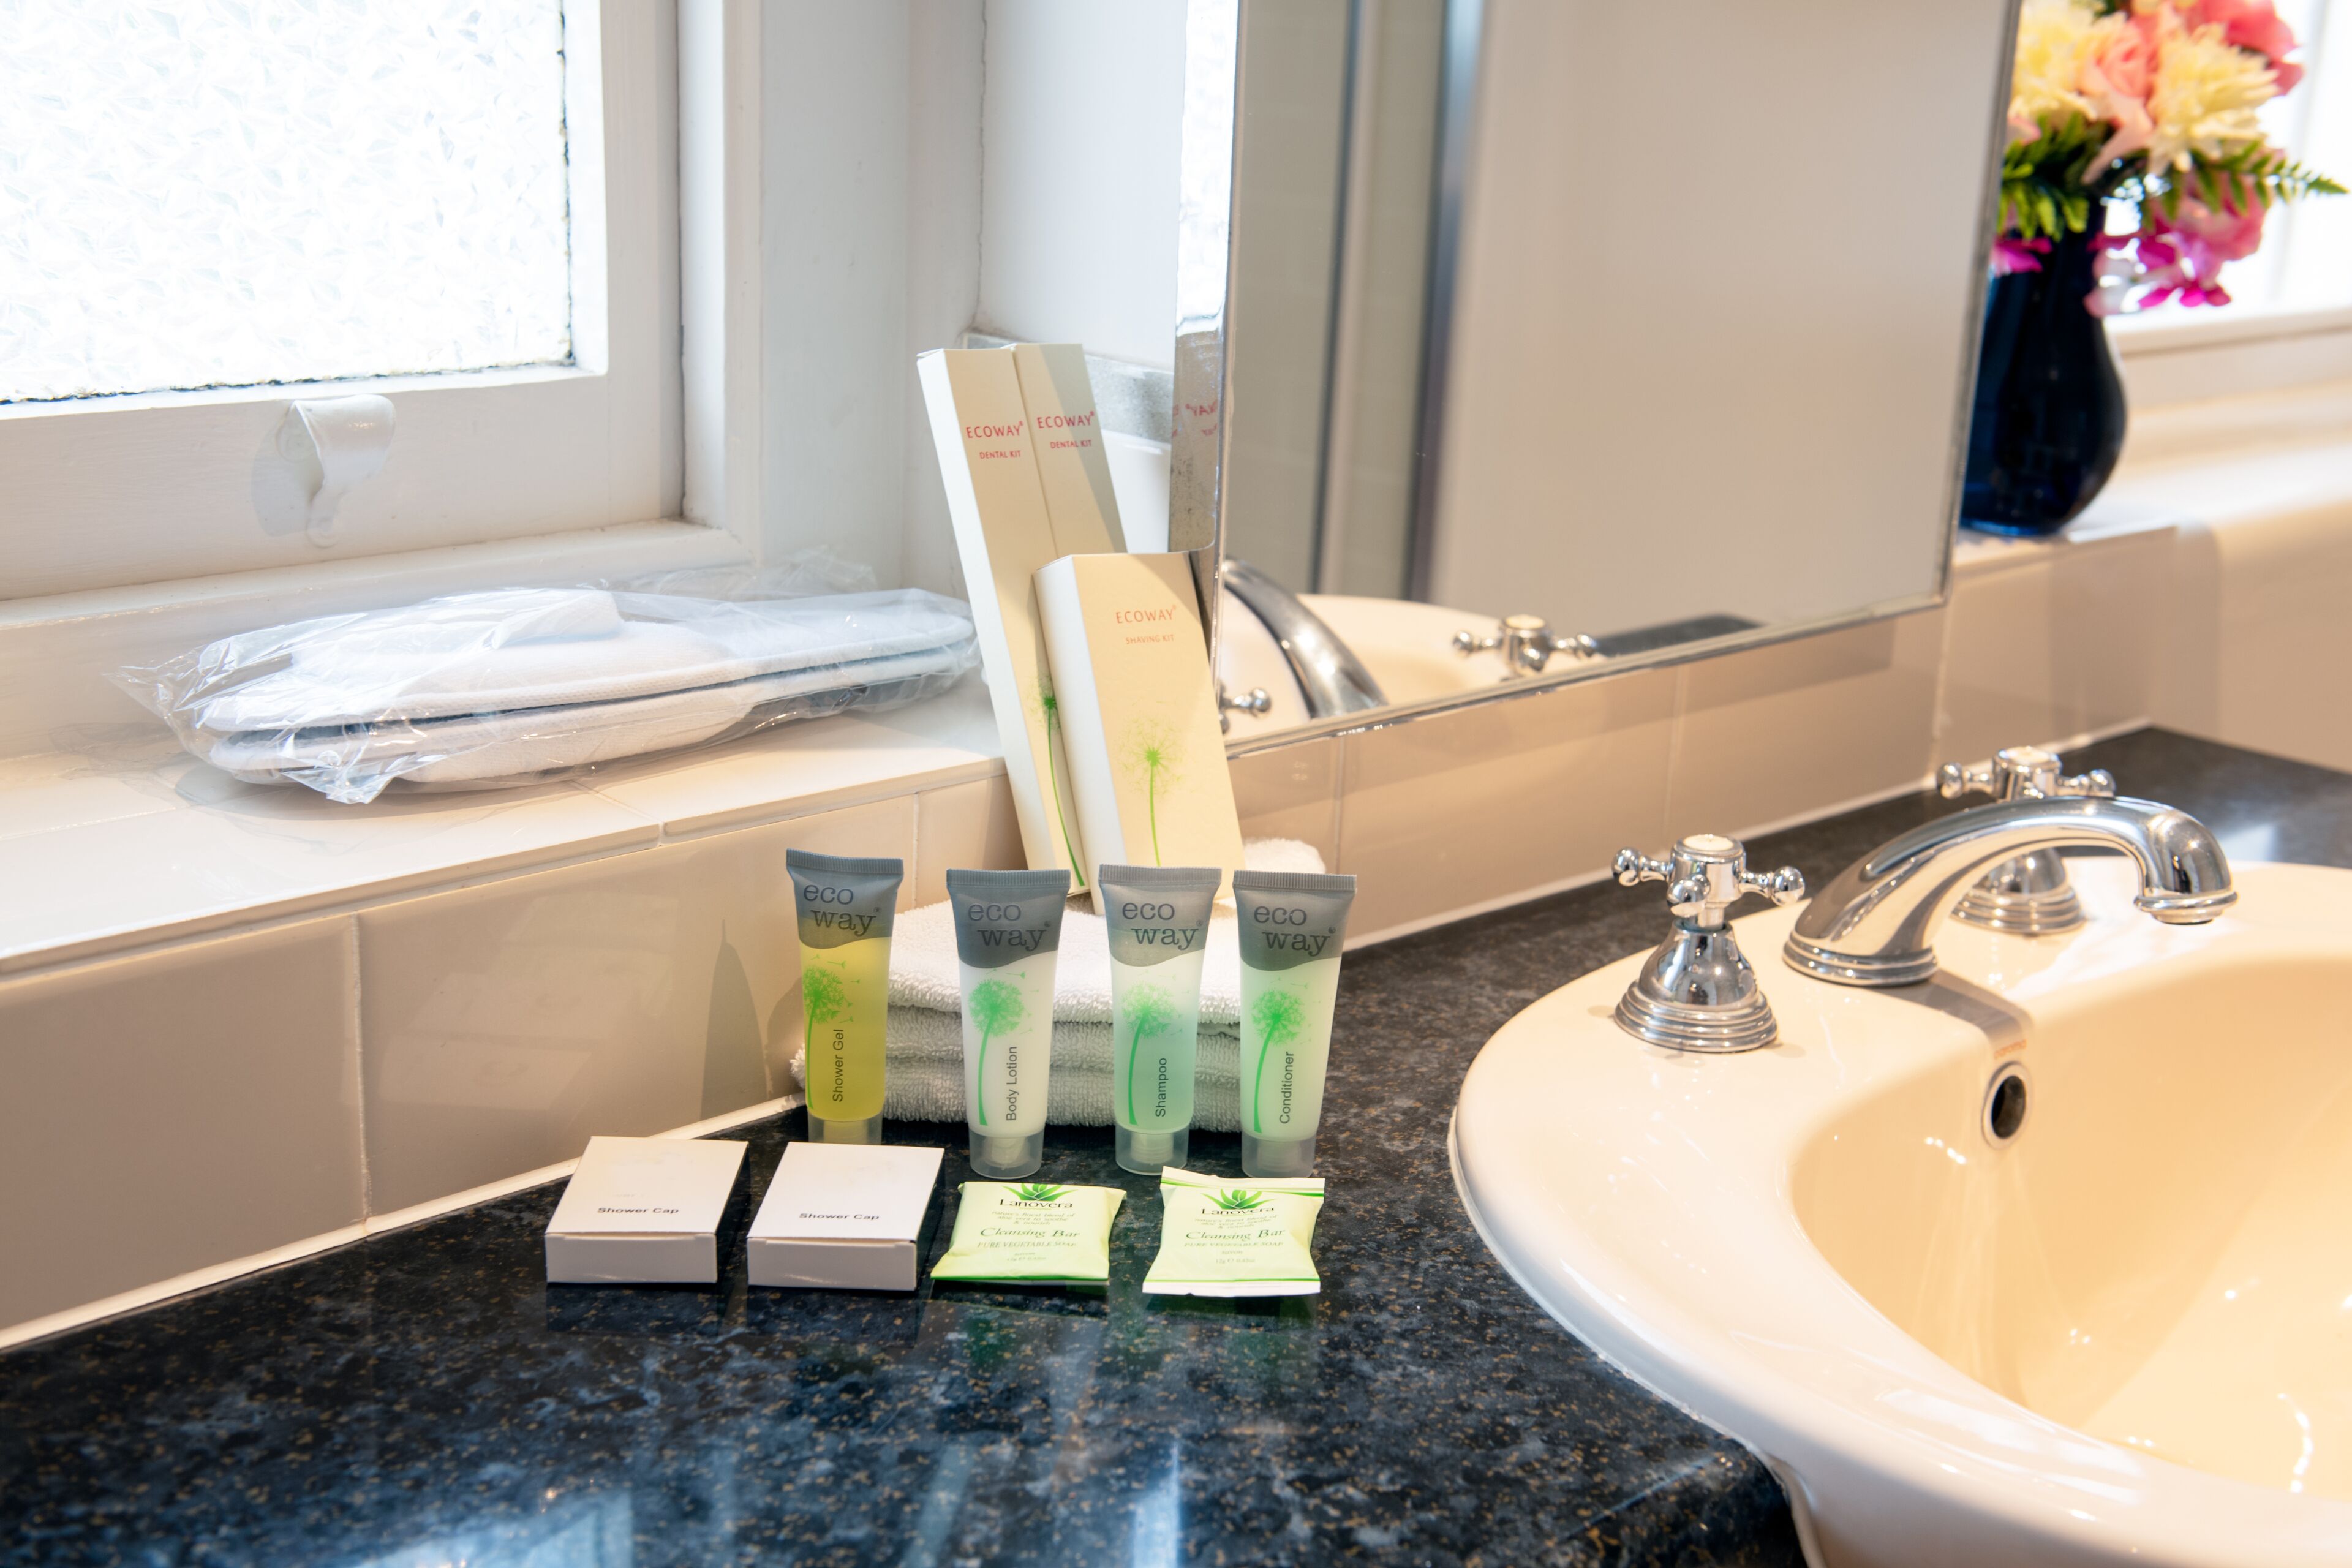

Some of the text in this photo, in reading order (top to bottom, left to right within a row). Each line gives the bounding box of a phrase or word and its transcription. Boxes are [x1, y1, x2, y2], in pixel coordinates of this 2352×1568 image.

[1050, 440, 1079, 449] DENTAL
[979, 451, 1008, 459] DENTAL
[1125, 635, 1161, 644] SHAVING
[804, 884, 854, 905] eco
[968, 903, 1022, 922] eco
[1122, 902, 1175, 920] eco
[1254, 906, 1307, 926] eco
[832, 1029, 844, 1102] Shower Gel
[1006, 1046, 1020, 1121] Body Lotion
[1155, 1058, 1169, 1117] Shampoo
[1280, 1051, 1294, 1124] Conditioner
[1000, 1199, 1073, 1208] Lanovera
[1201, 1207, 1275, 1215] Lanovera
[980, 1227, 1046, 1238] Cleansing
[1186, 1229, 1286, 1242] Cleansing Bar
